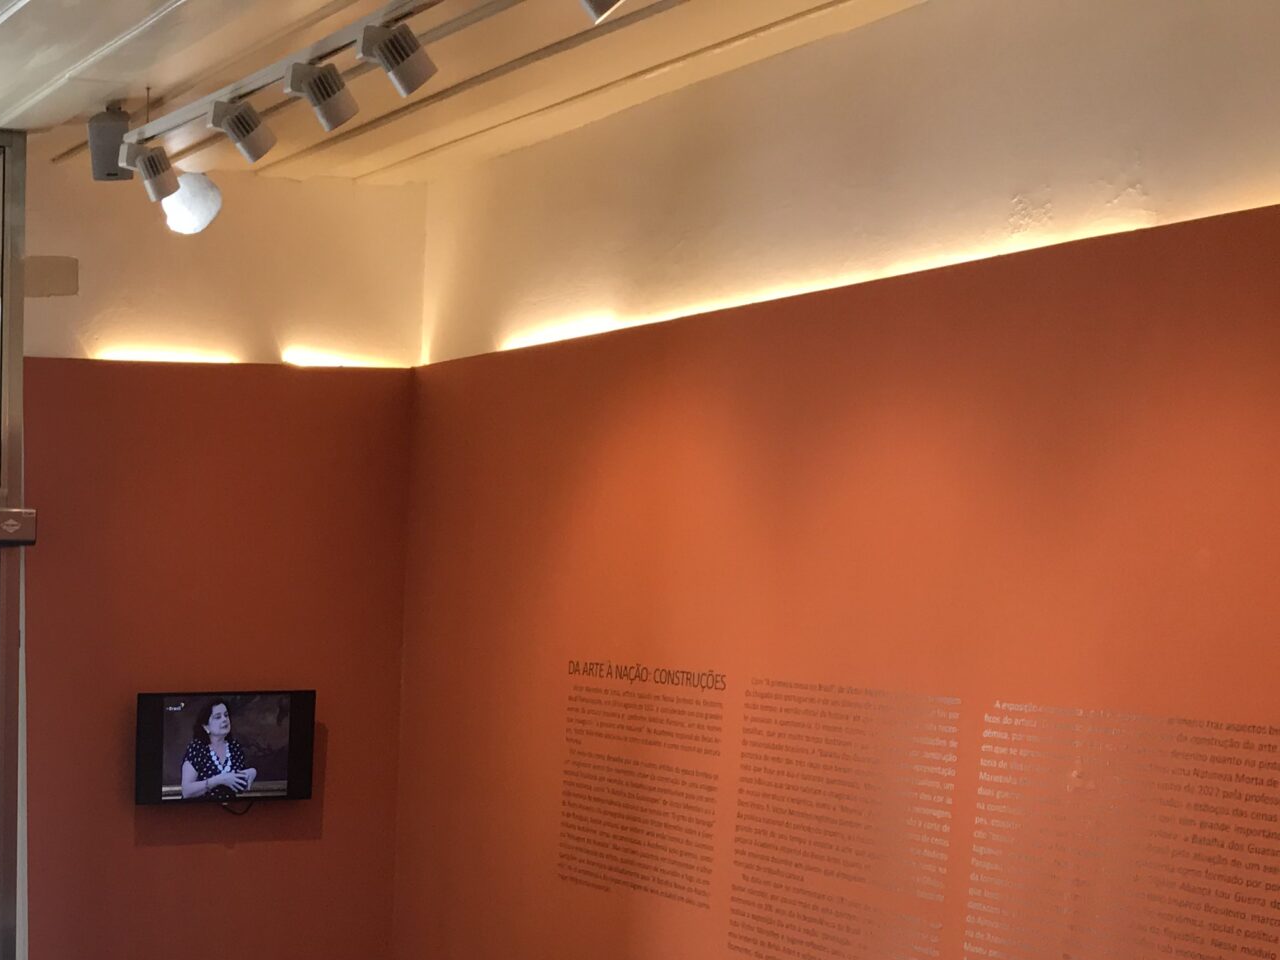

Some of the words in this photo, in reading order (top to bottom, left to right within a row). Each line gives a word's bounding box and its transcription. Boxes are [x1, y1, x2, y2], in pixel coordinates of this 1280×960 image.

[568, 660, 580, 675] DA
[582, 662, 605, 678] ARTE
[606, 661, 613, 679] À
[653, 668, 726, 691] CONSTRUÇÕES
[1235, 774, 1264, 786] Morta
[1234, 891, 1266, 907] Guerra
